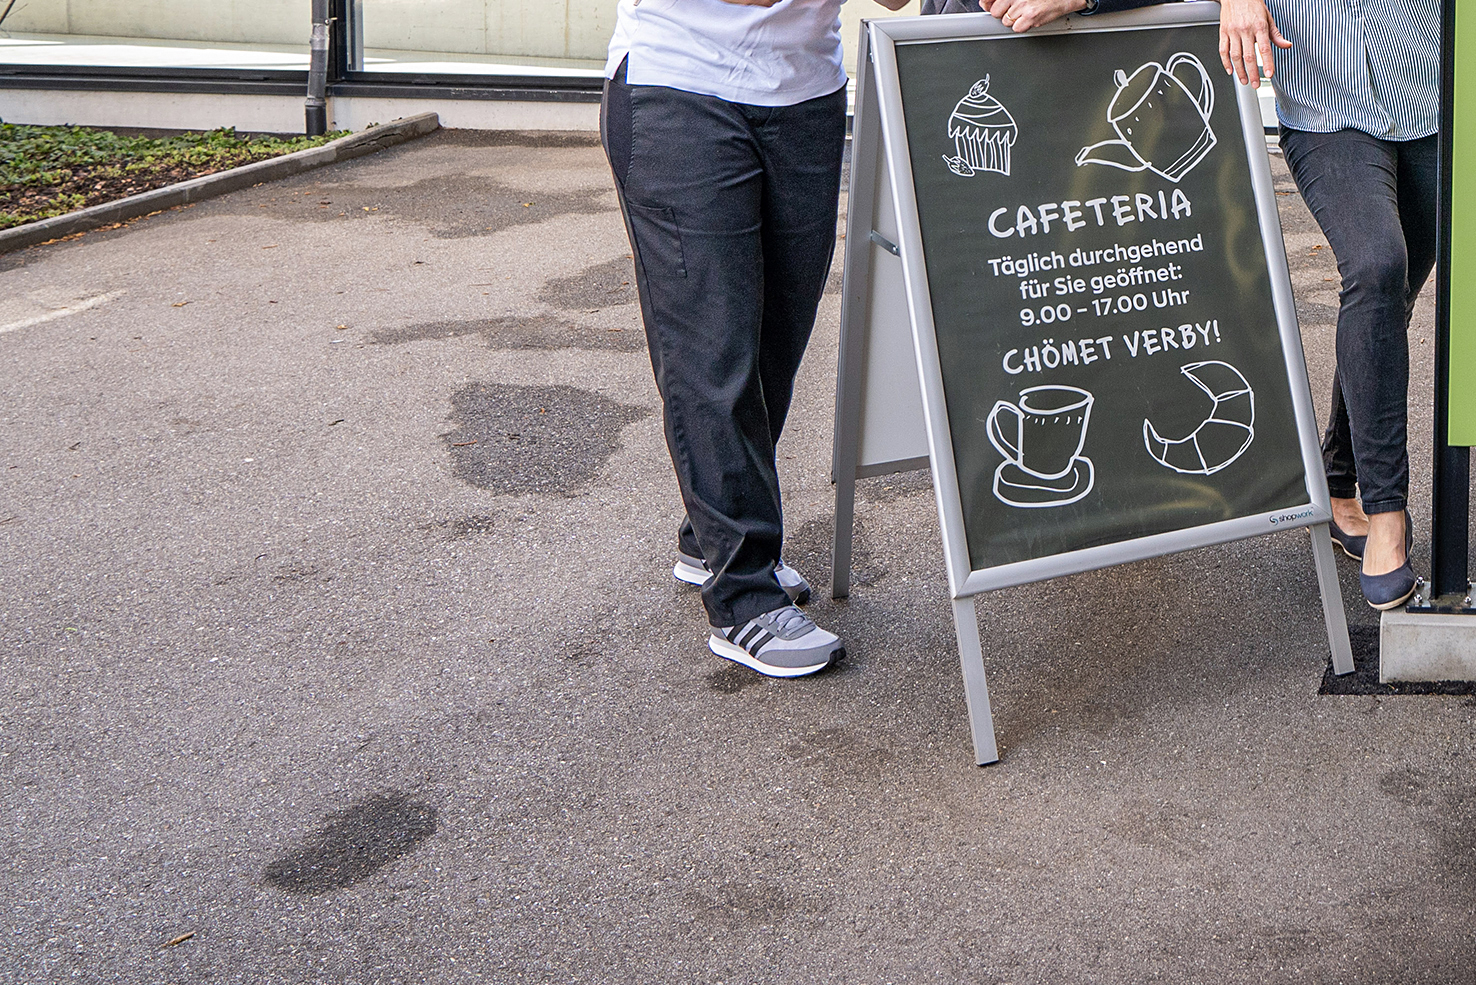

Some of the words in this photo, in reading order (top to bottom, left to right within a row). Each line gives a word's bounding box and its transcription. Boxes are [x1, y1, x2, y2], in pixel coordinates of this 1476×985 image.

[987, 188, 1192, 239] CAFETERIA
[987, 250, 1066, 278] Täglich
[1068, 233, 1204, 267] durchgehend
[1019, 278, 1051, 300] für
[1053, 274, 1087, 296] Sie
[1090, 262, 1183, 295] geöffnet:
[1019, 303, 1072, 327] 9.00
[1091, 293, 1148, 317] 17.00
[1151, 288, 1190, 308] Uhr
[1002, 335, 1114, 375] CHÖMET
[1122, 319, 1222, 358] VERBY!
[1279, 509, 1314, 523] shopwork
